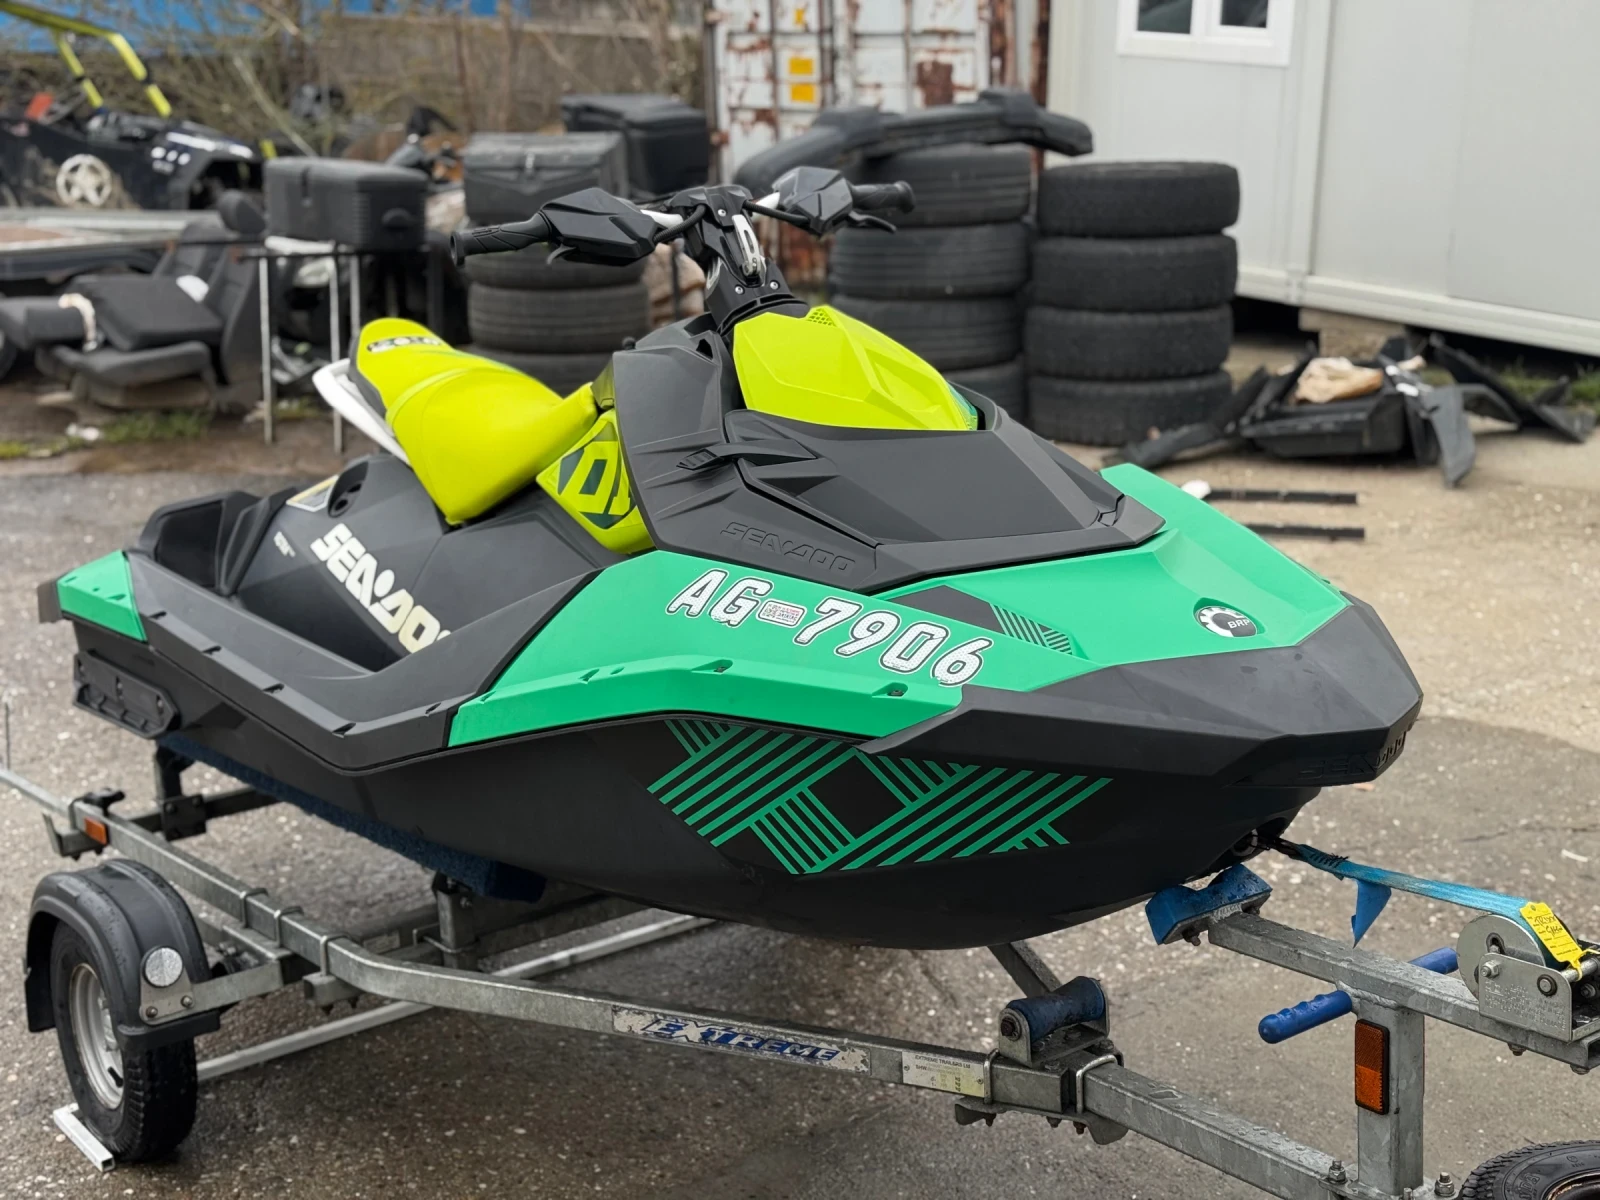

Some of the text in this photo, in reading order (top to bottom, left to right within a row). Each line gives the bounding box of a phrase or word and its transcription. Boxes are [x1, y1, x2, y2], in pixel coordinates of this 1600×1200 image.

[1227, 619, 1250, 629] BRP
[641, 1018, 841, 1062] EXTREME
[915, 1055, 938, 1063] EXTREME
